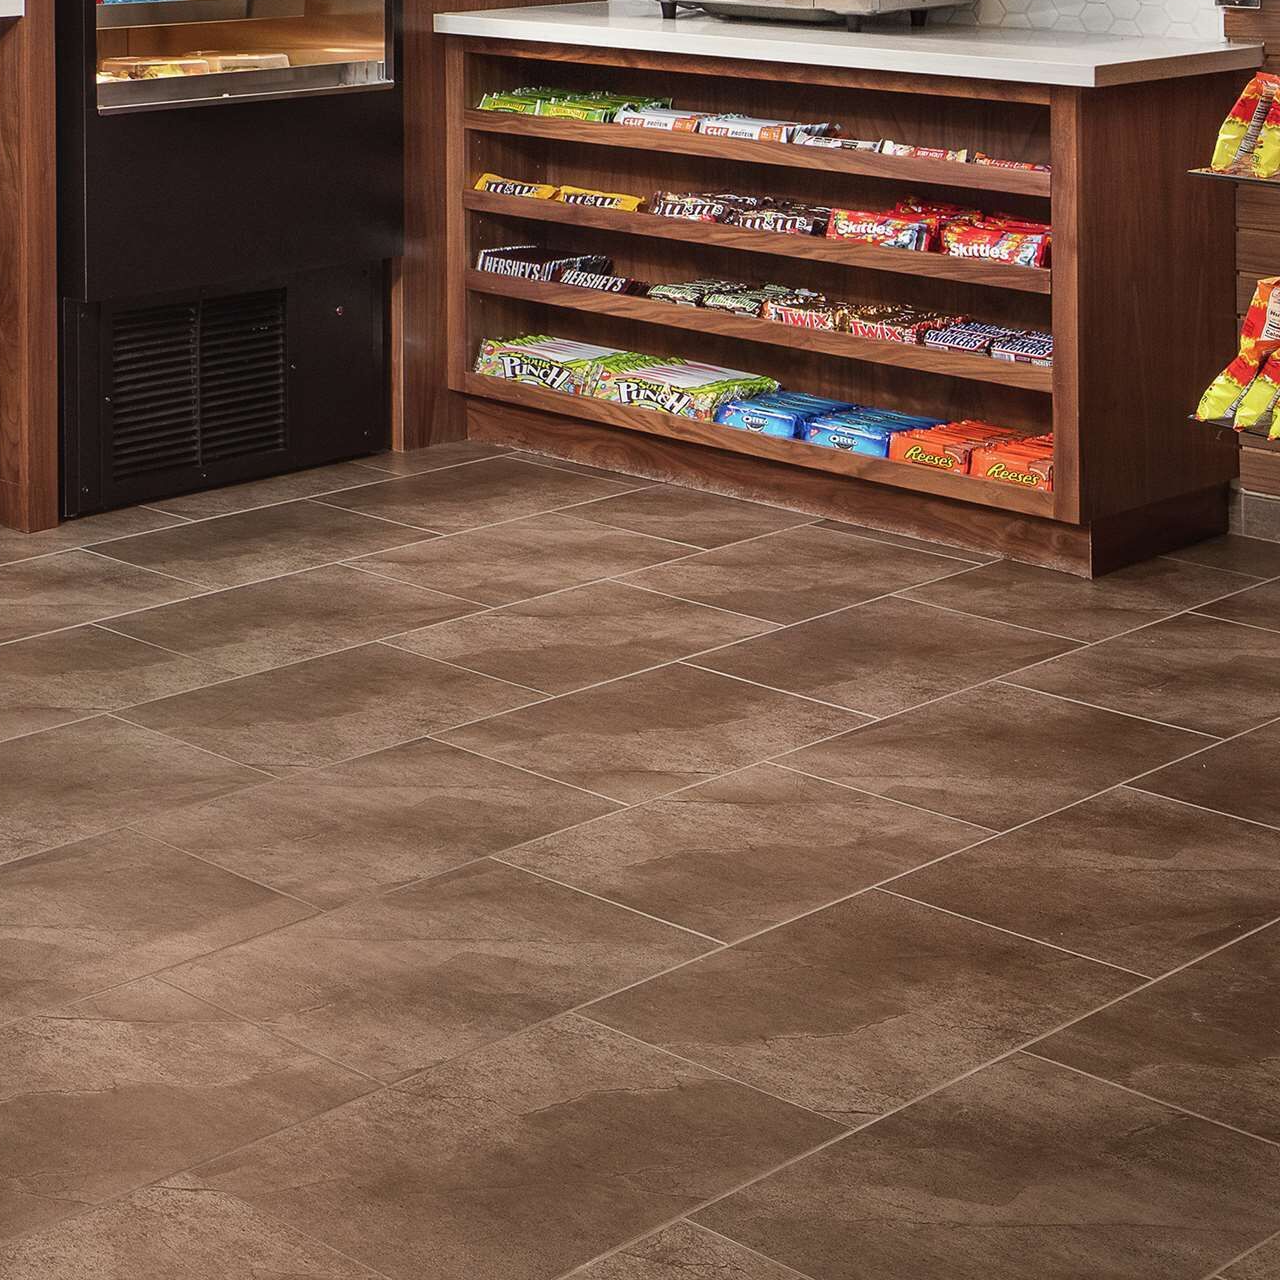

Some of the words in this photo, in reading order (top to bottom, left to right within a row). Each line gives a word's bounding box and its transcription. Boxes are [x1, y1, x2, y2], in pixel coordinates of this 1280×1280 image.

[623, 118, 645, 127] CLIF
[705, 127, 728, 136] CLIF
[838, 220, 895, 237] Skittles
[948, 242, 1011, 260] Skittles
[484, 256, 541, 280] HERSHEY'S
[559, 270, 626, 293] HERSHEY'S
[926, 330, 981, 350] SNICKERS
